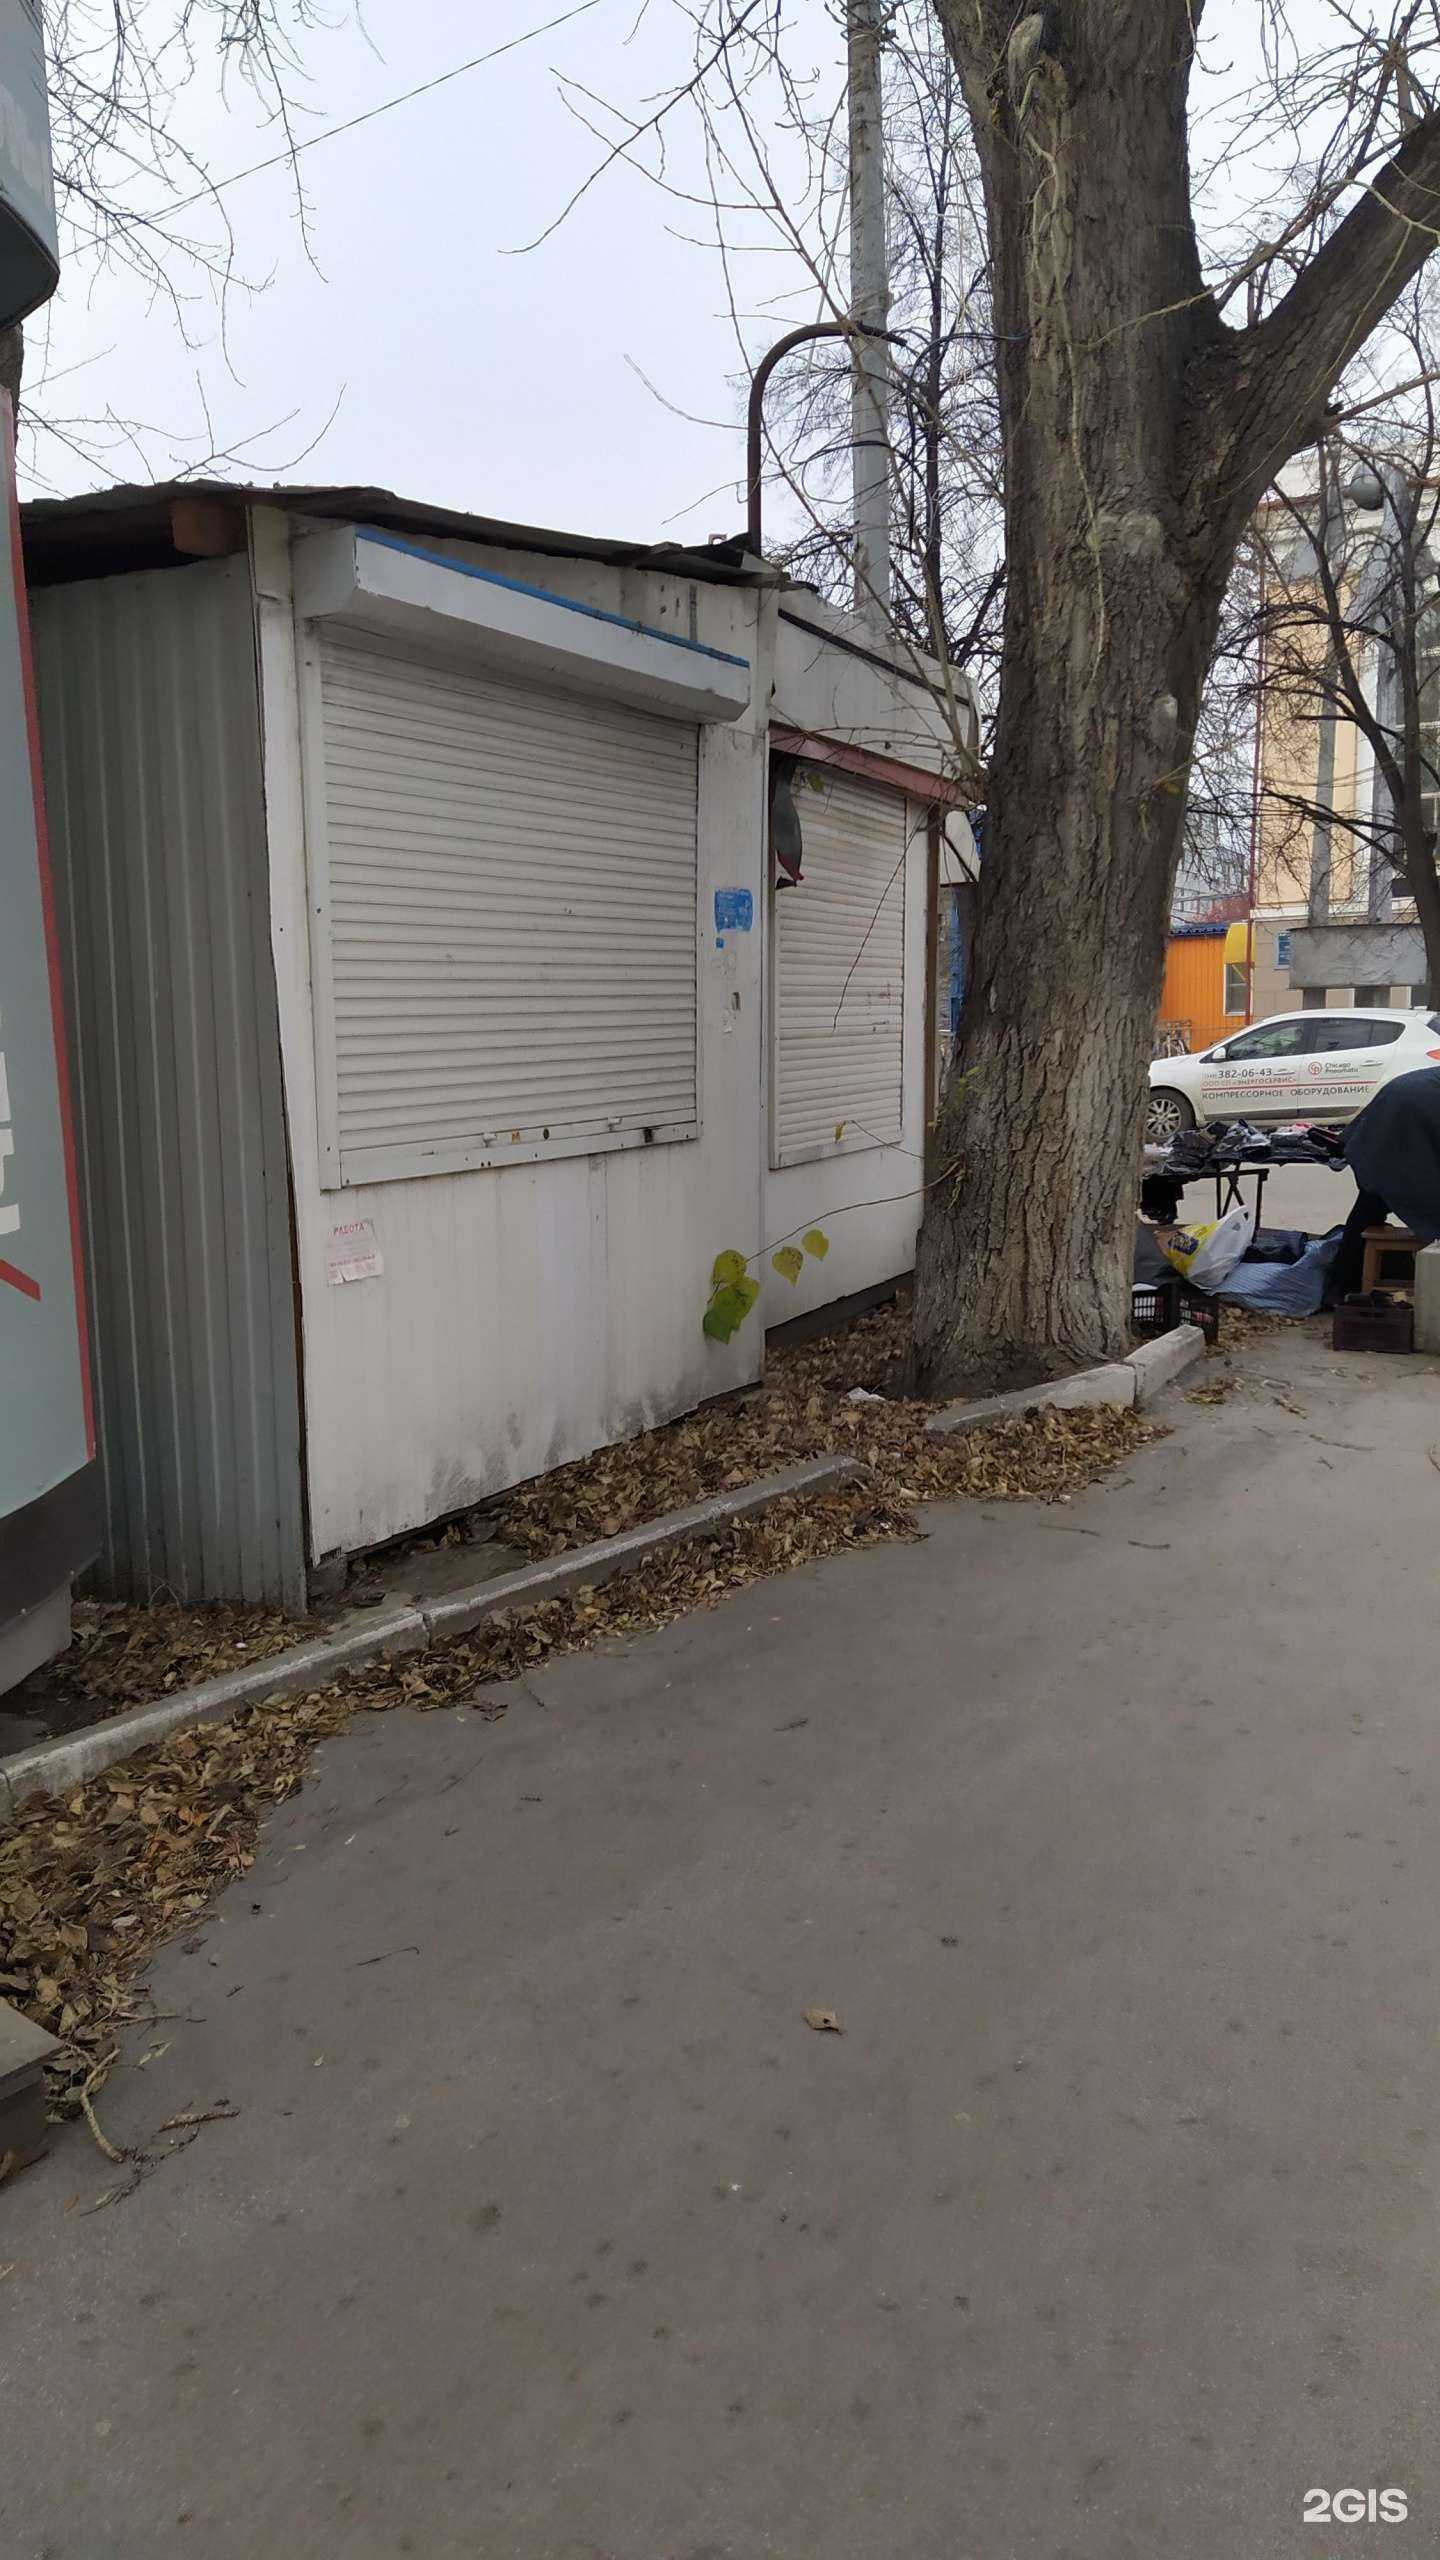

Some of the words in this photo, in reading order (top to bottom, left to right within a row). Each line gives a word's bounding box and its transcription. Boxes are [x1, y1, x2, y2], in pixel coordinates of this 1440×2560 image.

[1218, 1067, 1272, 1079] 382-06-43
[1202, 1080, 1219, 1088] ООО
[1202, 1089, 1283, 1100] КОМПРЕССОРНОЕ
[1290, 1085, 1370, 1097] ОБОРУДОВАНИЕ
